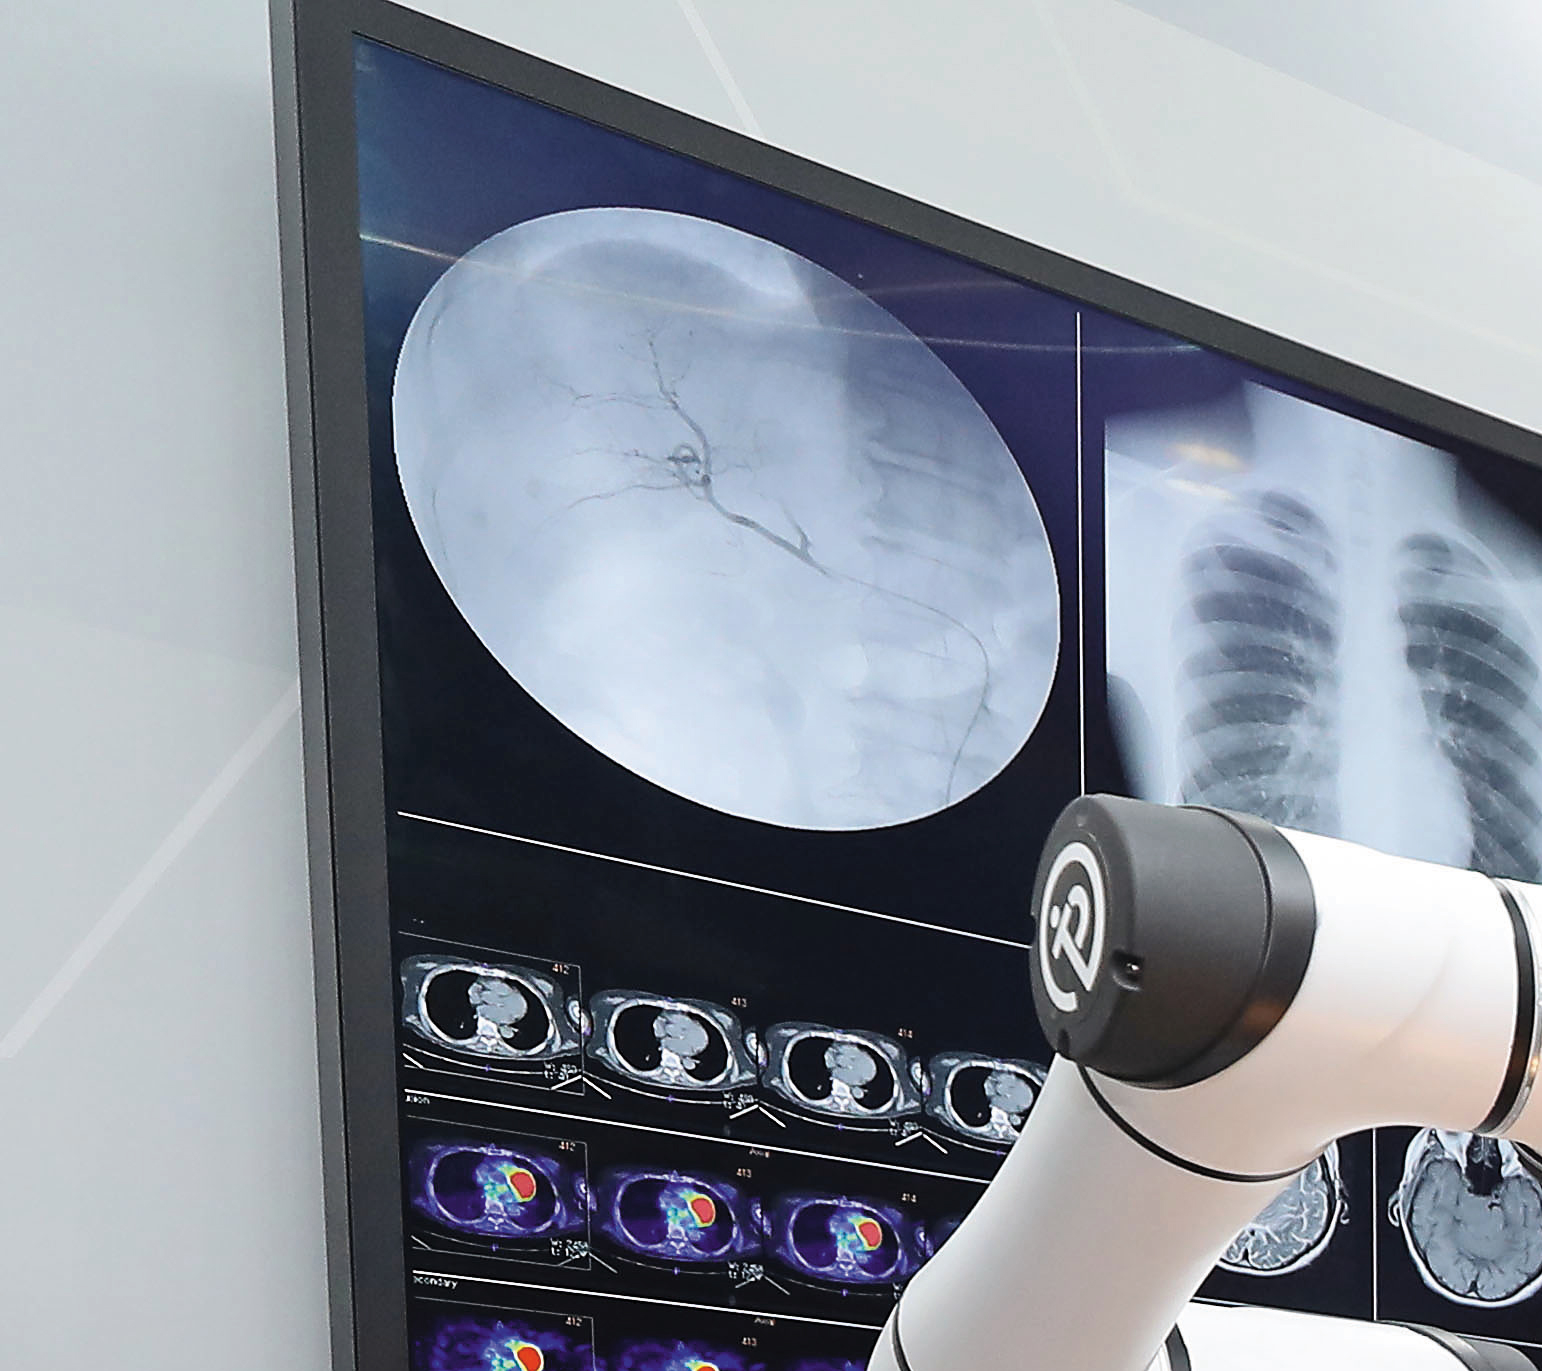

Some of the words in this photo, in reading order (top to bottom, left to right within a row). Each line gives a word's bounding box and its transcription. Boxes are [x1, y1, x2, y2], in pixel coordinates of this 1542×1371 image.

[552, 963, 570, 975] 412
[559, 1142, 576, 1151] 412
[736, 1168, 752, 1178] 413
